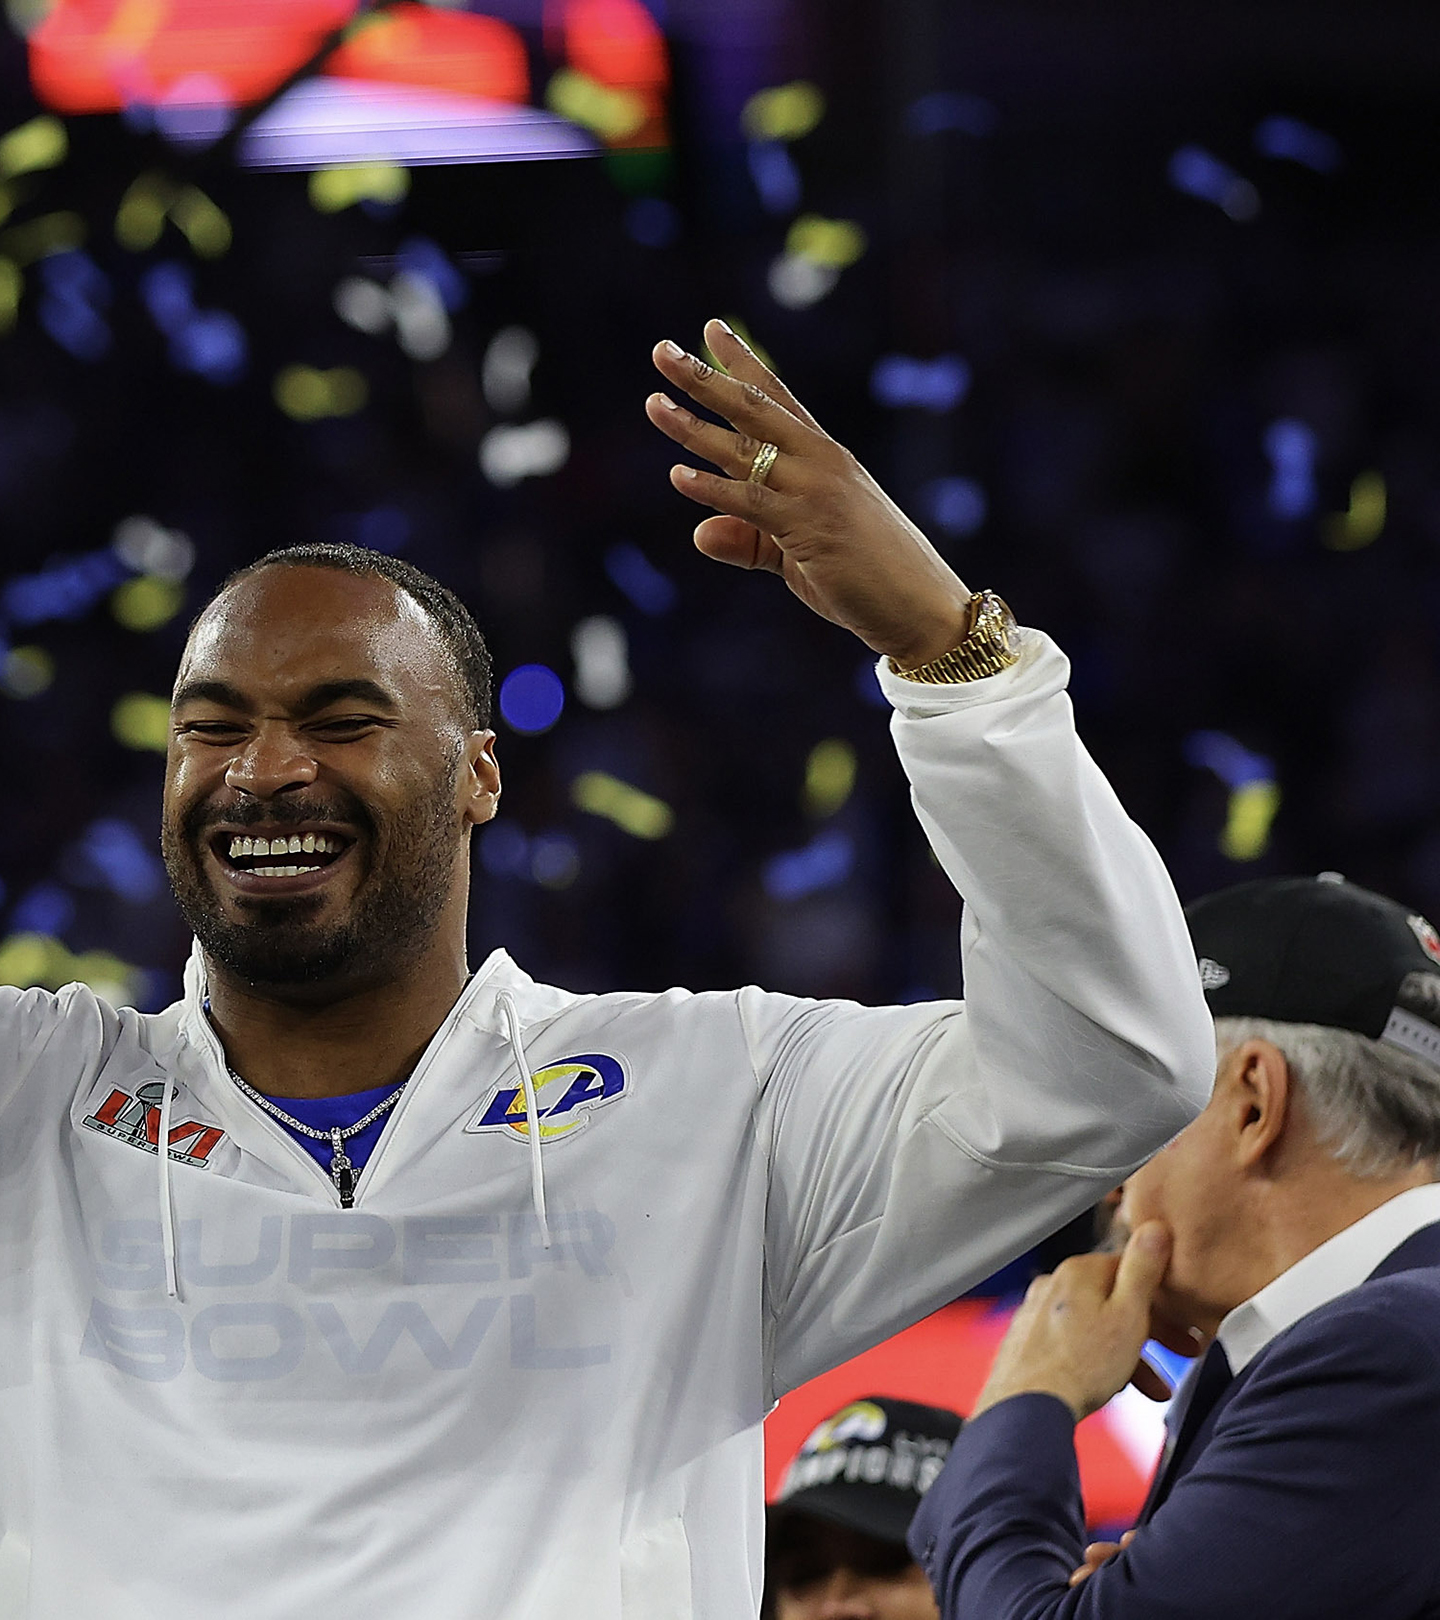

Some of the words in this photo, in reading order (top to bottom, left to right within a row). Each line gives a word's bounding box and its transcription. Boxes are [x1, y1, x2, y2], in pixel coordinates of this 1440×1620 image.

[94, 1088, 225, 1160] LVI
[96, 1123, 147, 1148] SUPER
[96, 1210, 618, 1292] SUPER
[80, 1294, 611, 1382] BOWL
